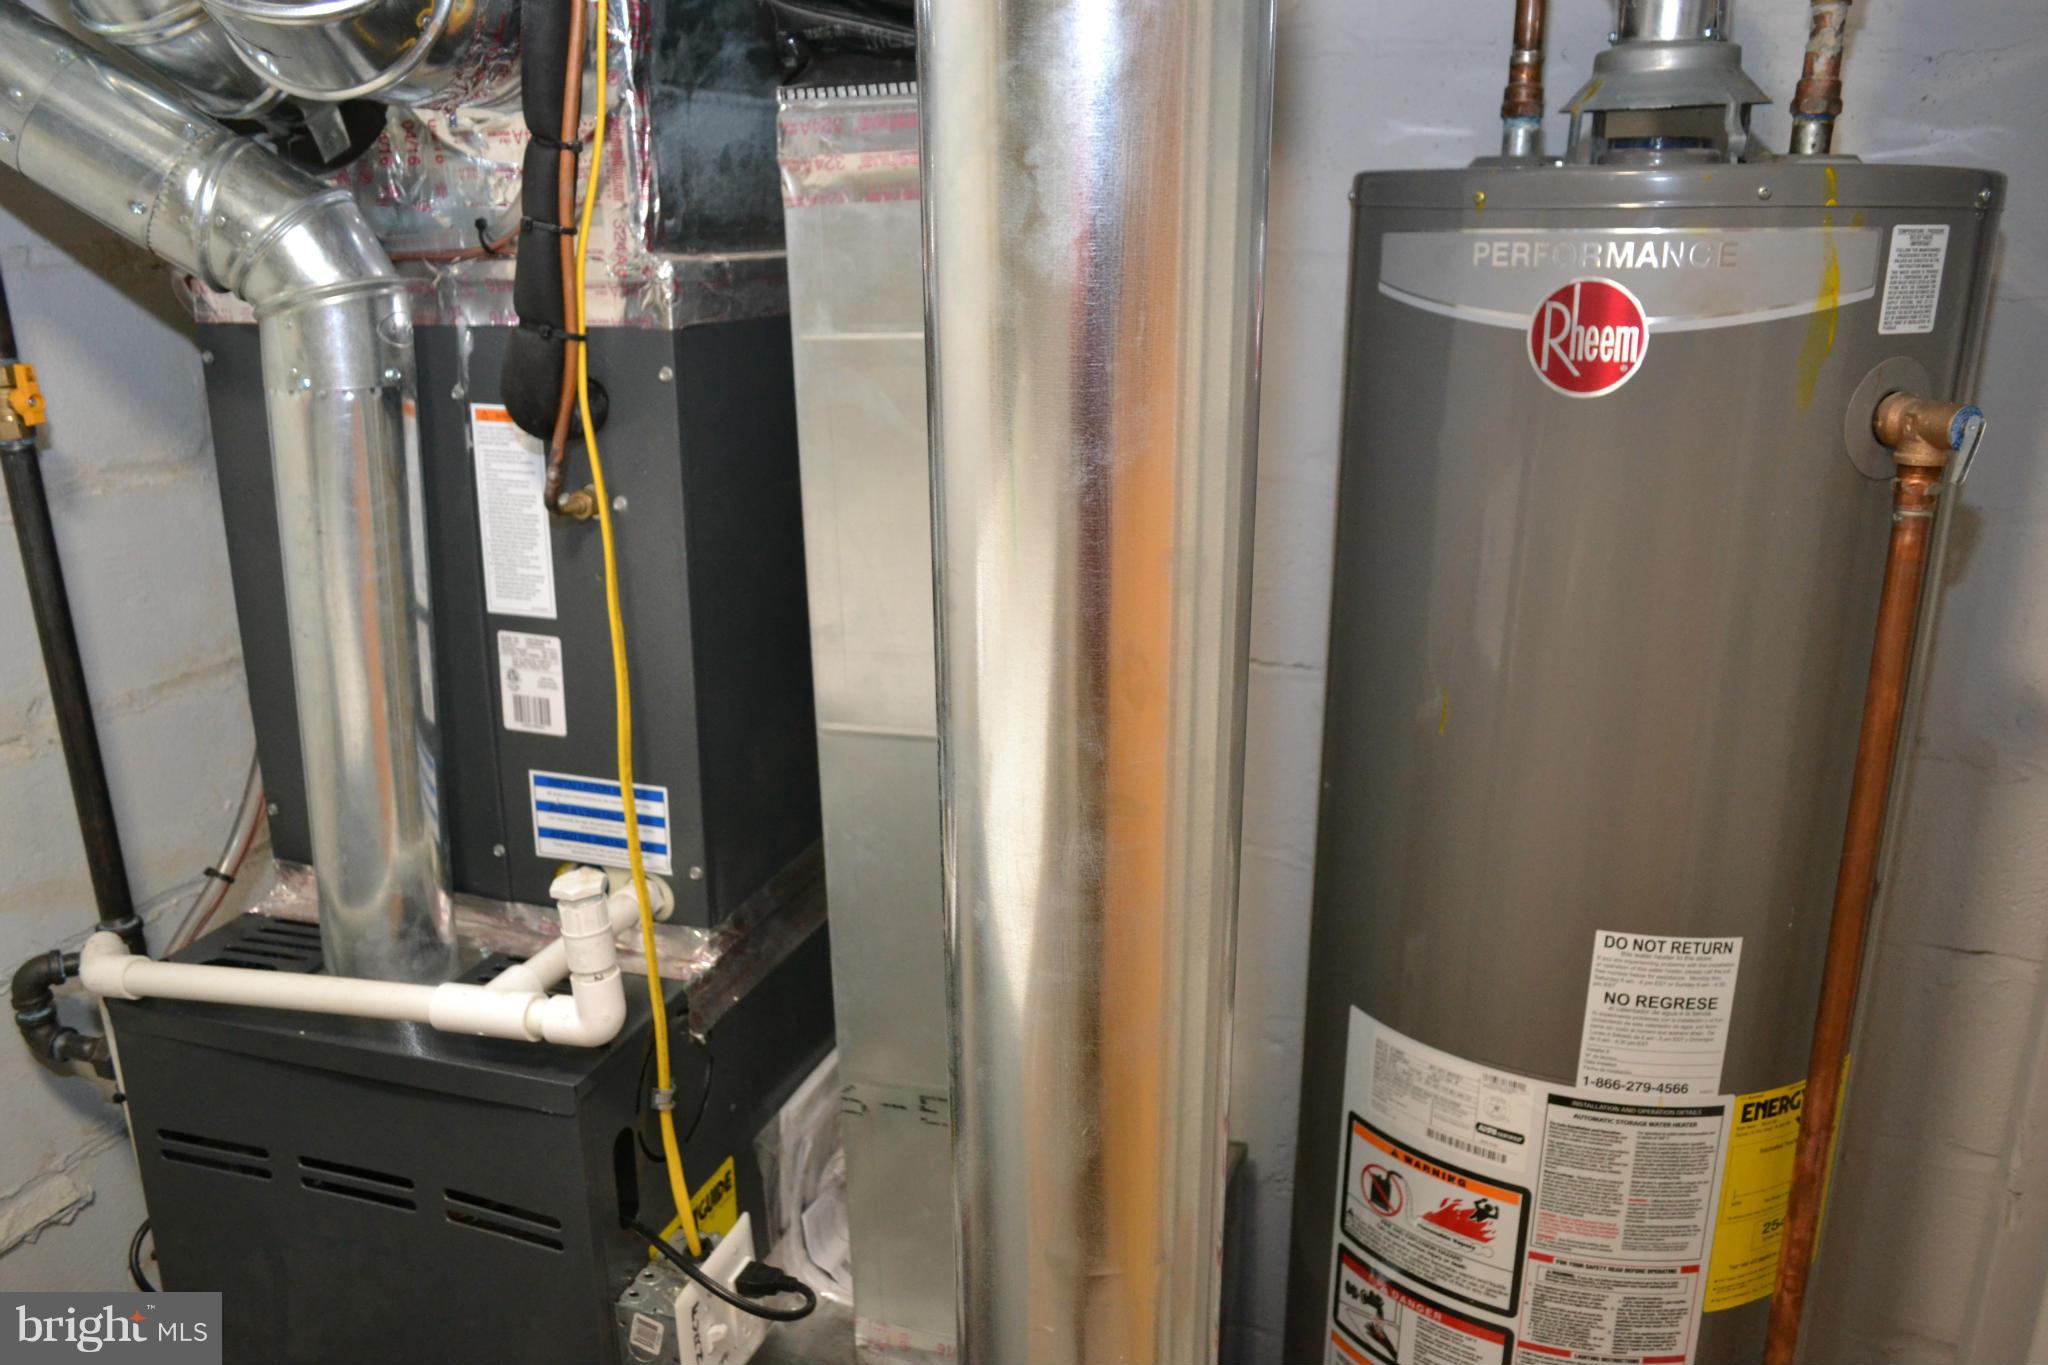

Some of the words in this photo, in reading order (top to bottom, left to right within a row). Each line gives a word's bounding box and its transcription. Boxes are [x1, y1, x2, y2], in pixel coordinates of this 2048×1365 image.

[1473, 240, 1737, 270] PERFORMANCE
[1540, 281, 1641, 378] Rheem
[1604, 935, 1628, 950] DO
[1632, 938, 1667, 953] NOT
[1671, 941, 1734, 955] RETURN
[1603, 991, 1630, 1006] NO
[1635, 994, 1719, 1010] REGRESE
[1583, 1075, 1689, 1094] 1-866-279-4566
[1572, 1113, 1615, 1125] AUTOMATIC
[1616, 1118, 1647, 1127] STORAGE
[1649, 1120, 1672, 1128] WATER
[1741, 1089, 1806, 1123] ENERG
[1404, 1154, 1467, 1189] WARNING
[1391, 1289, 1443, 1321] DANGER
